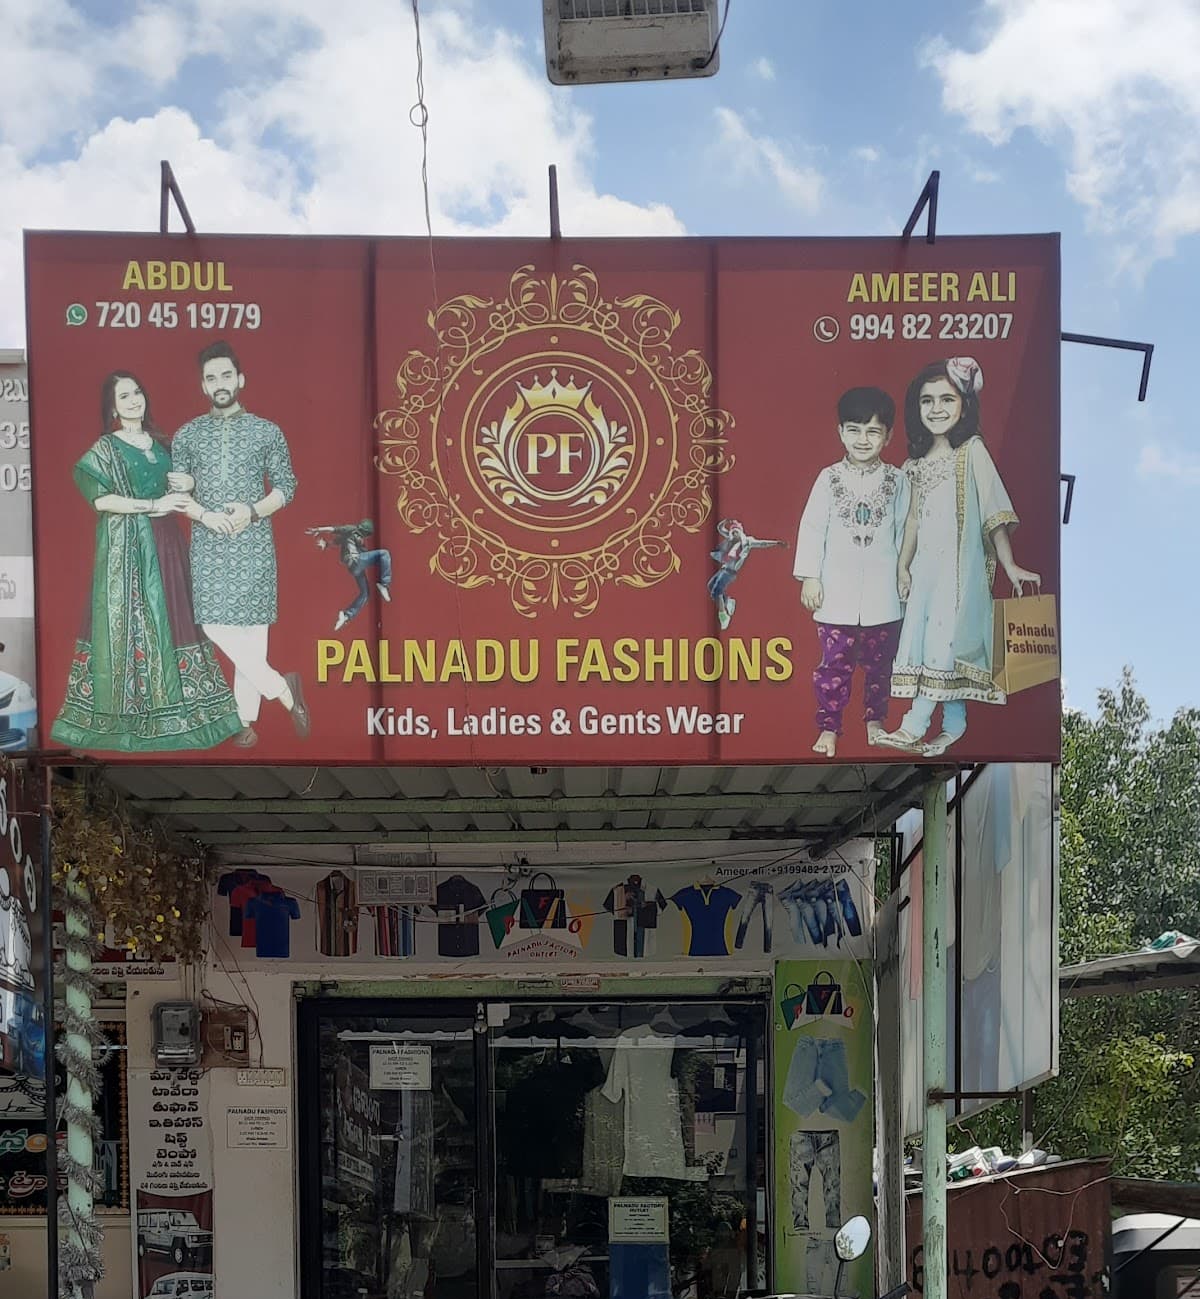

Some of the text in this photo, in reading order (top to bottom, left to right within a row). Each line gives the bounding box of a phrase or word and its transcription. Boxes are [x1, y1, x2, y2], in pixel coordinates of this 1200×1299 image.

[122, 260, 233, 292] ABDUL
[847, 272, 1017, 303] AMEER ALI
[95, 302, 261, 330] 720 45 19779
[850, 313, 1013, 340] 994 82 23207
[525, 432, 586, 475] PF
[1008, 622, 1055, 637] Palnadu
[317, 637, 794, 682] PALNADU FASHIONS
[1006, 639, 1058, 655] Fashions
[367, 705, 745, 739] Kids, Ladies & Gents Wear
